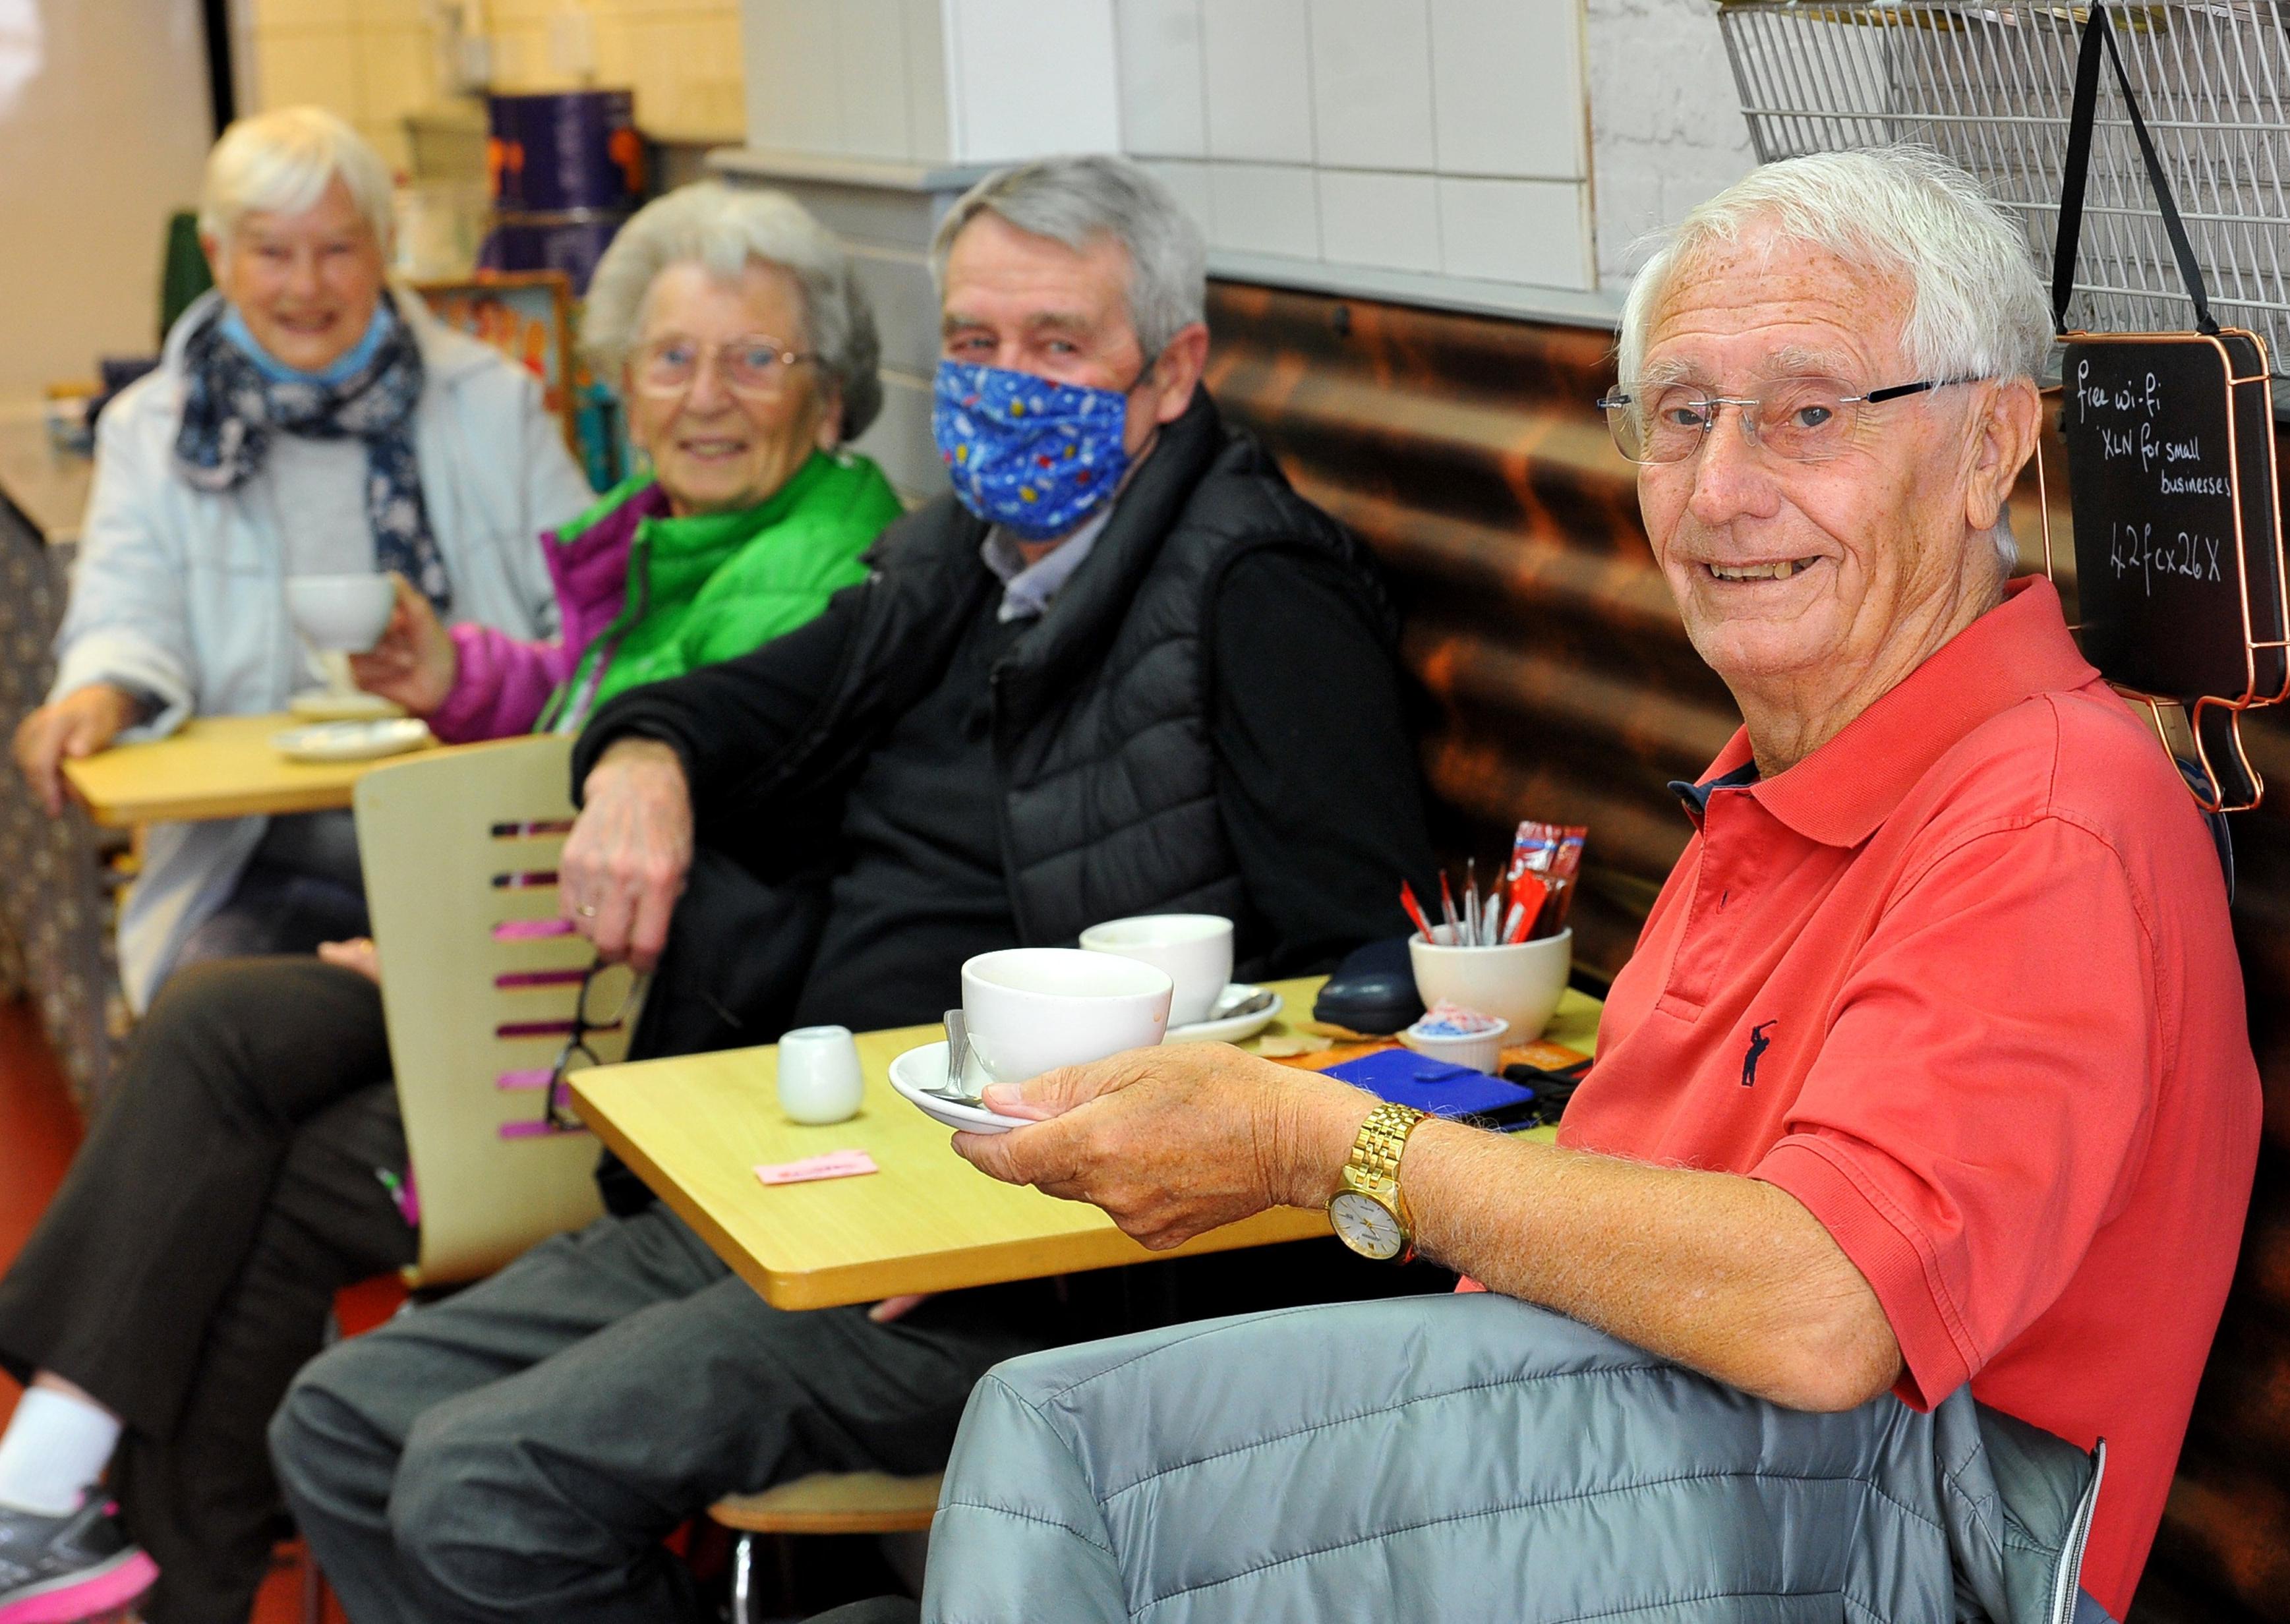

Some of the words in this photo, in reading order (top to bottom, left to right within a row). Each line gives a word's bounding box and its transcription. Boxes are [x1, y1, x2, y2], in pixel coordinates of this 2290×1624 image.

[2078, 359, 2109, 424] free
[2115, 372, 2161, 418] wi-fi
[2101, 428, 2132, 460] XLN
[2140, 422, 2159, 473] for
[2166, 436, 2200, 462] small
[2161, 469, 2231, 497] businesses
